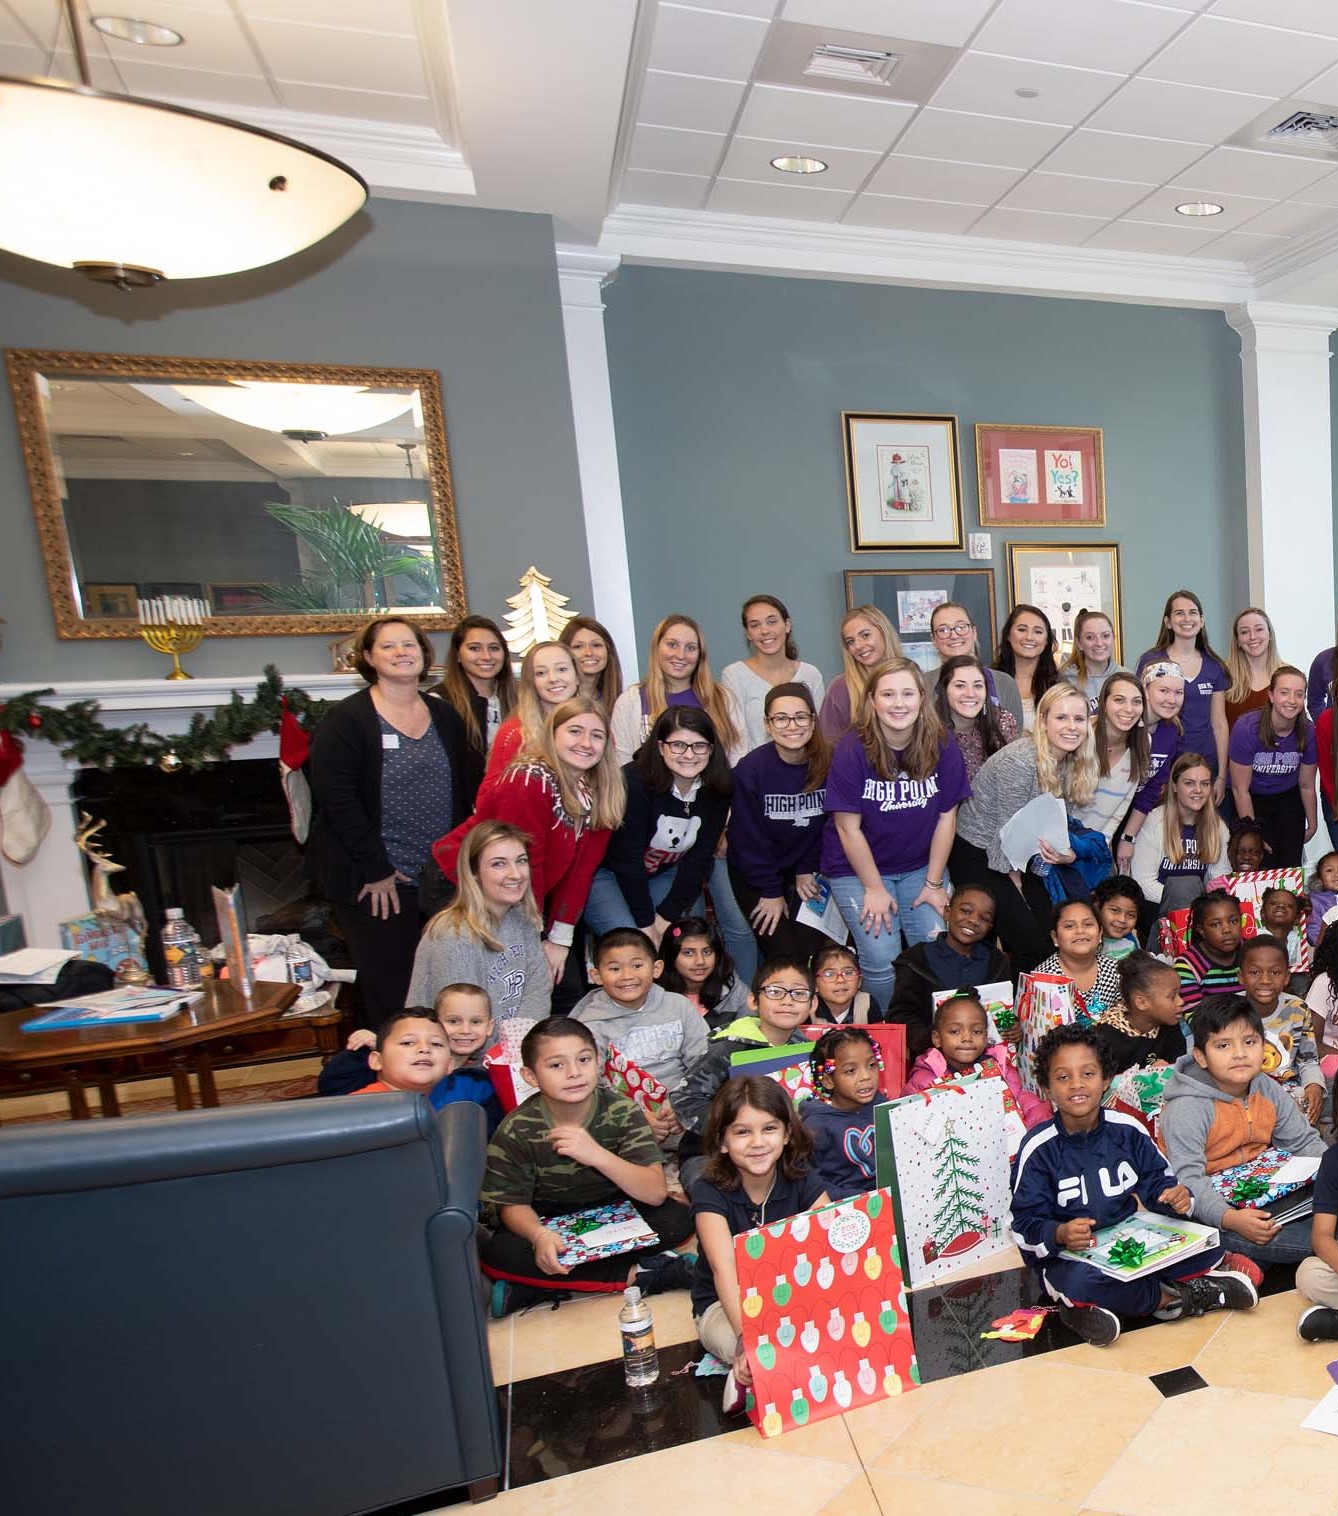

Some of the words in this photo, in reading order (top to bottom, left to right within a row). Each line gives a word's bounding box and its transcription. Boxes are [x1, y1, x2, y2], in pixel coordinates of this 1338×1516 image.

[1052, 453, 1073, 470] Yo!
[1050, 469, 1078, 487] Yes?
[1252, 763, 1298, 774] UNIVERSITY
[861, 779, 896, 801] HIGH
[766, 796, 796, 814] HIGH
[798, 790, 827, 811] POIN
[879, 797, 928, 812] University
[1057, 1160, 1139, 1208] FILA
[841, 1223, 857, 1232] FOR
[841, 1229, 859, 1241] YOU
